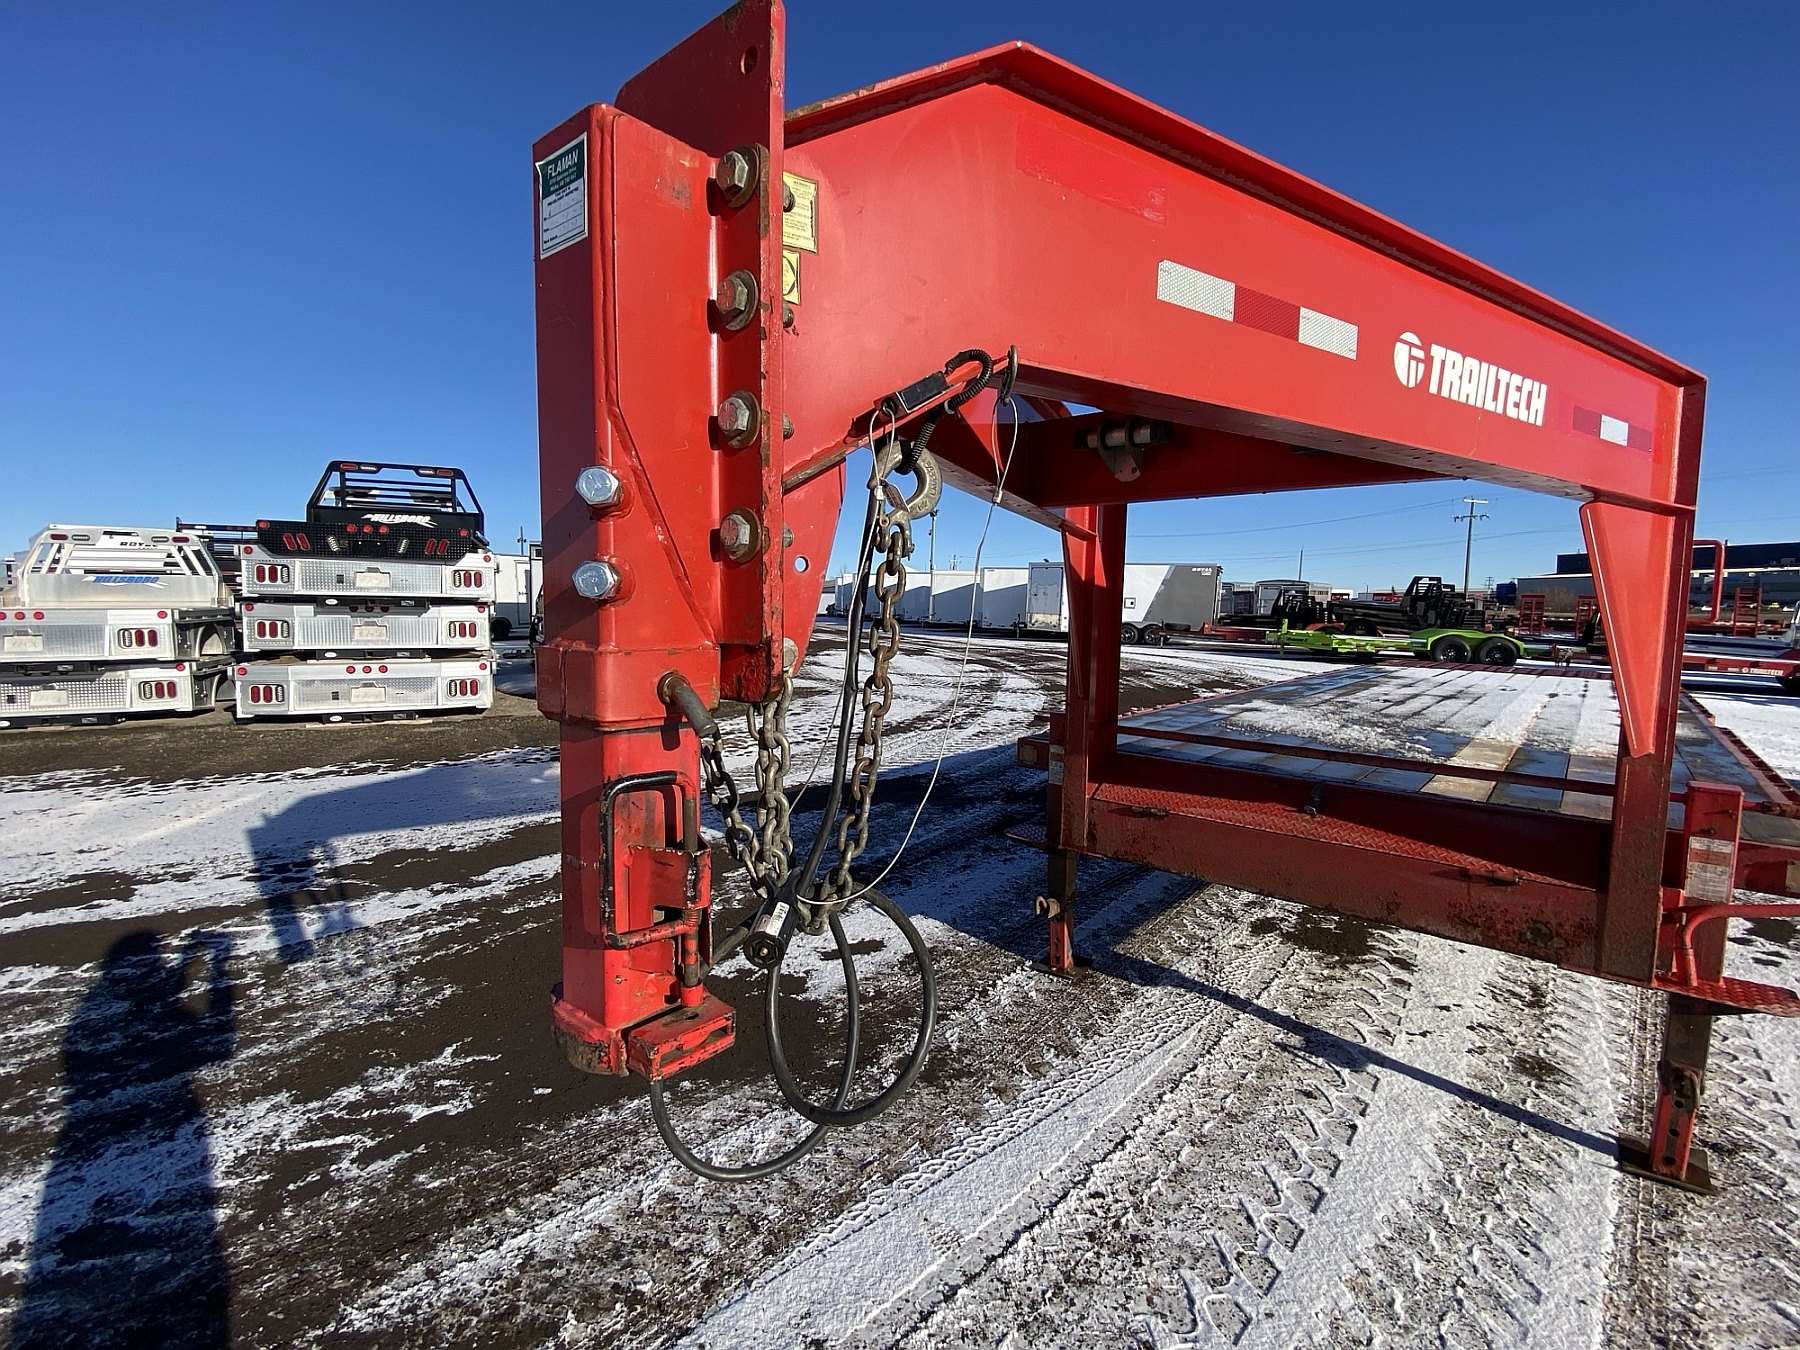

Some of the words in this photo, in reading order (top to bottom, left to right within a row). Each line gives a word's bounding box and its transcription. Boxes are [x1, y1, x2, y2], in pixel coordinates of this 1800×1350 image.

[547, 149, 578, 179] FLAMAN
[1429, 344, 1547, 426] TRAILTECH
[371, 514, 431, 523] HILLSBORO
